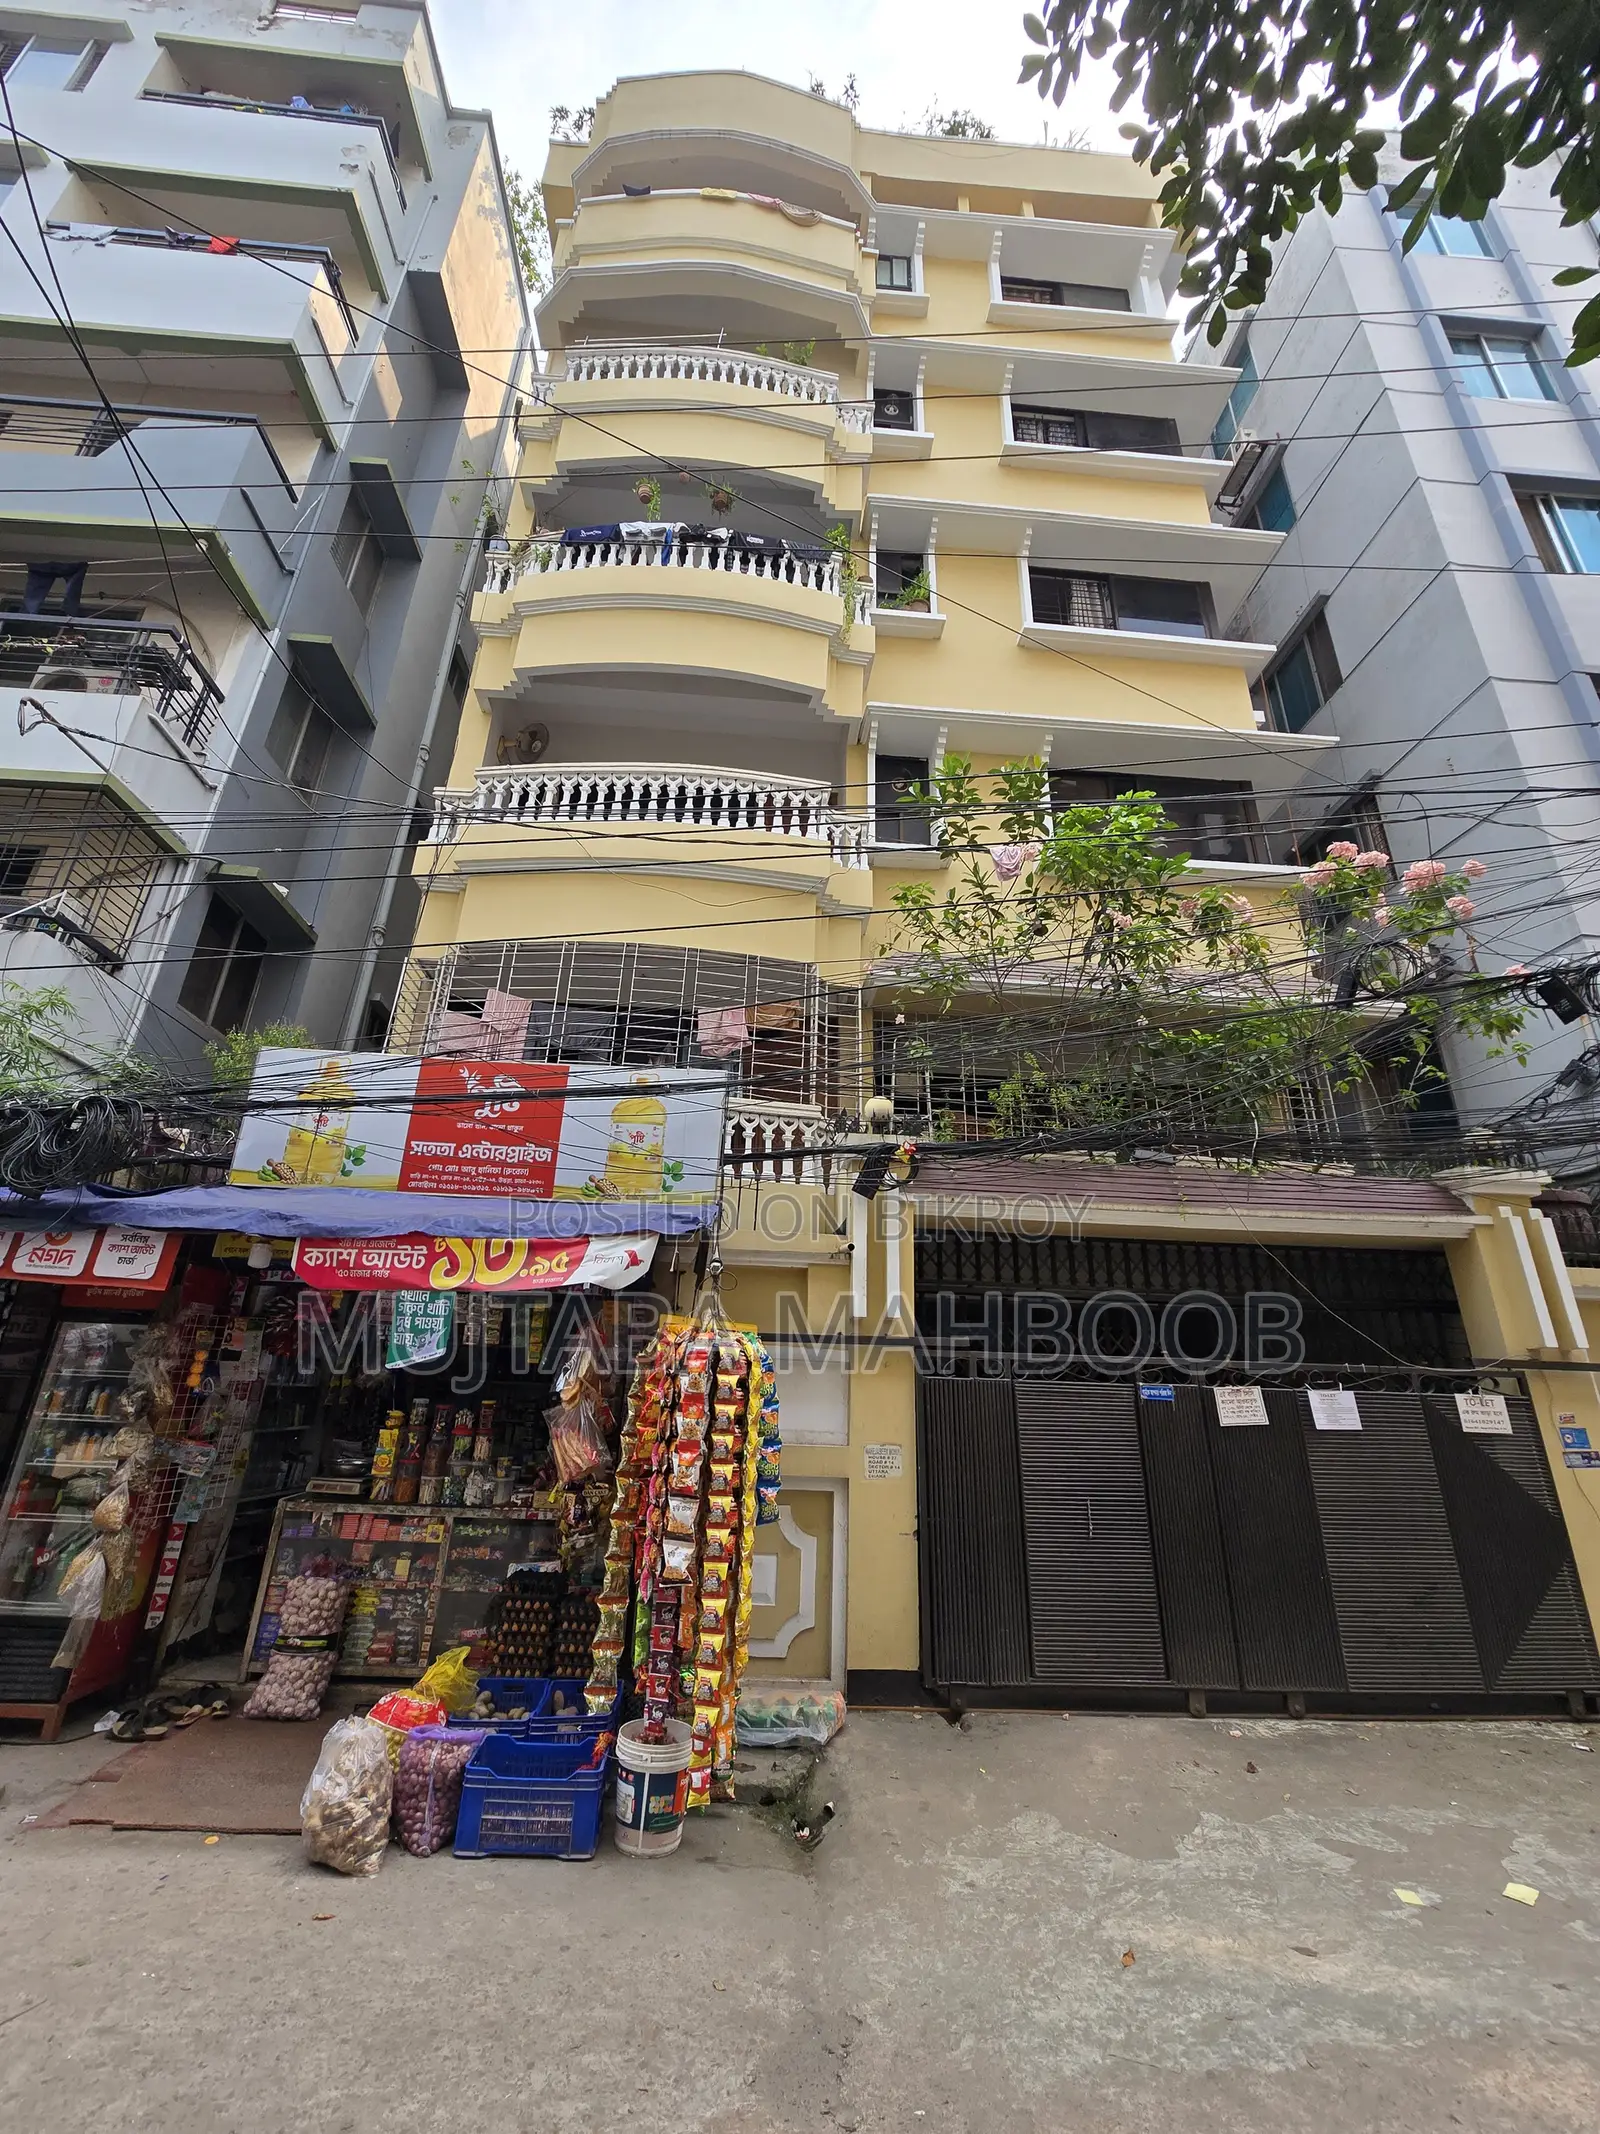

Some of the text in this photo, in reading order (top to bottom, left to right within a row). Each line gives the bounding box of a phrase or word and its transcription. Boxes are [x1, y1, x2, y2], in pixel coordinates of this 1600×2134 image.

[409, 1140, 553, 1163] সততা এন্টারপ্রাইজ
[107, 1243, 156, 1255] ক্যাশ আউট
[28, 1247, 77, 1266] নগদ
[117, 1254, 138, 1265] চার্জ
[303, 1245, 428, 1269] ক্যাশ আউট
[349, 1269, 370, 1278] হাজার
[399, 1290, 430, 1302] এখানে
[398, 1302, 425, 1316] গরুর
[414, 1317, 445, 1333] পাওয়া
[1463, 1397, 1495, 1407] TO-LET
